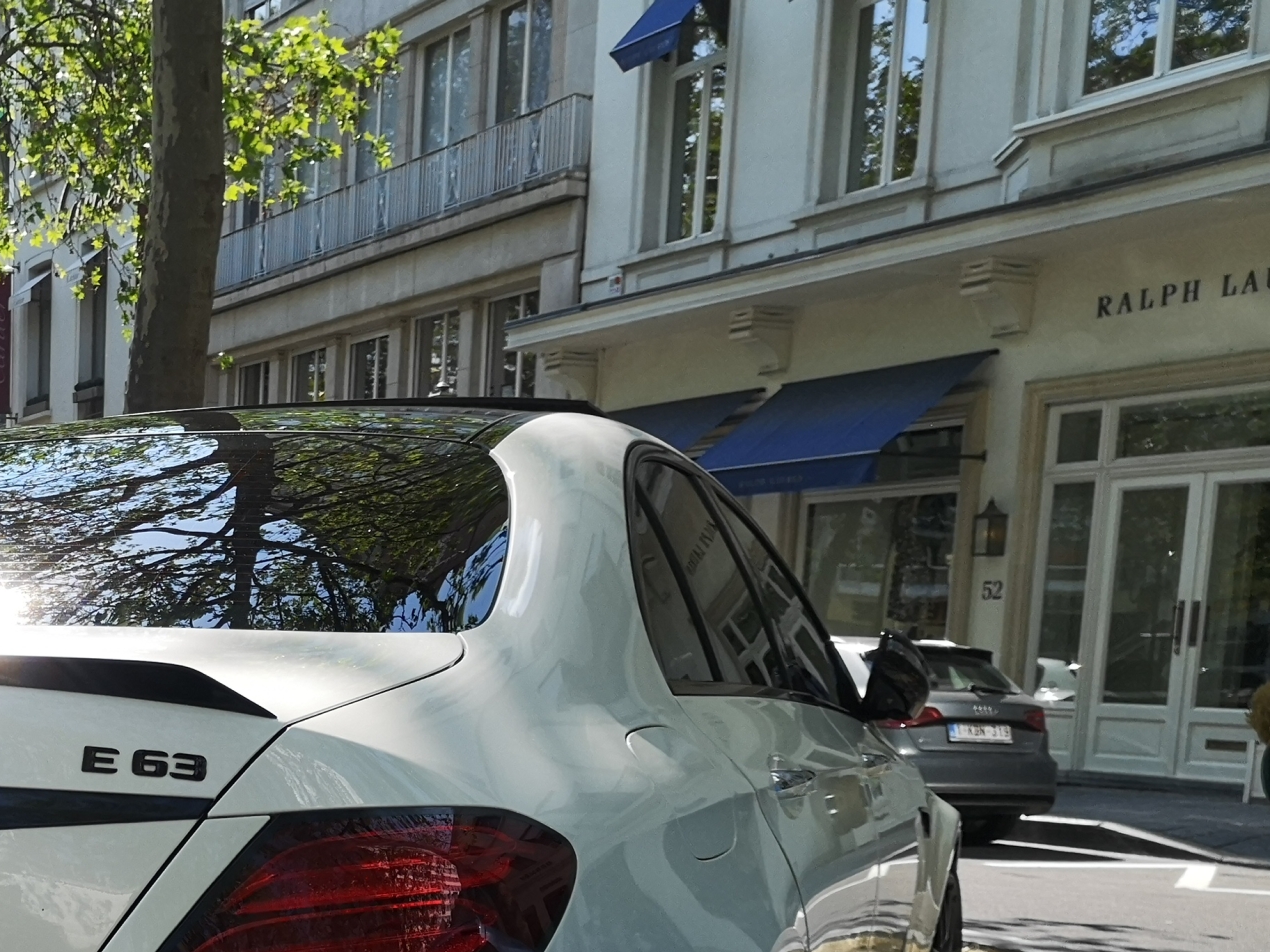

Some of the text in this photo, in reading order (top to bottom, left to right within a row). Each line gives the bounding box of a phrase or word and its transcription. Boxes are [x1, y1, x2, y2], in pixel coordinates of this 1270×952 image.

[1096, 267, 1270, 319] RALPH LA
[982, 580, 1004, 600] 52
[81, 745, 208, 782] E 63
